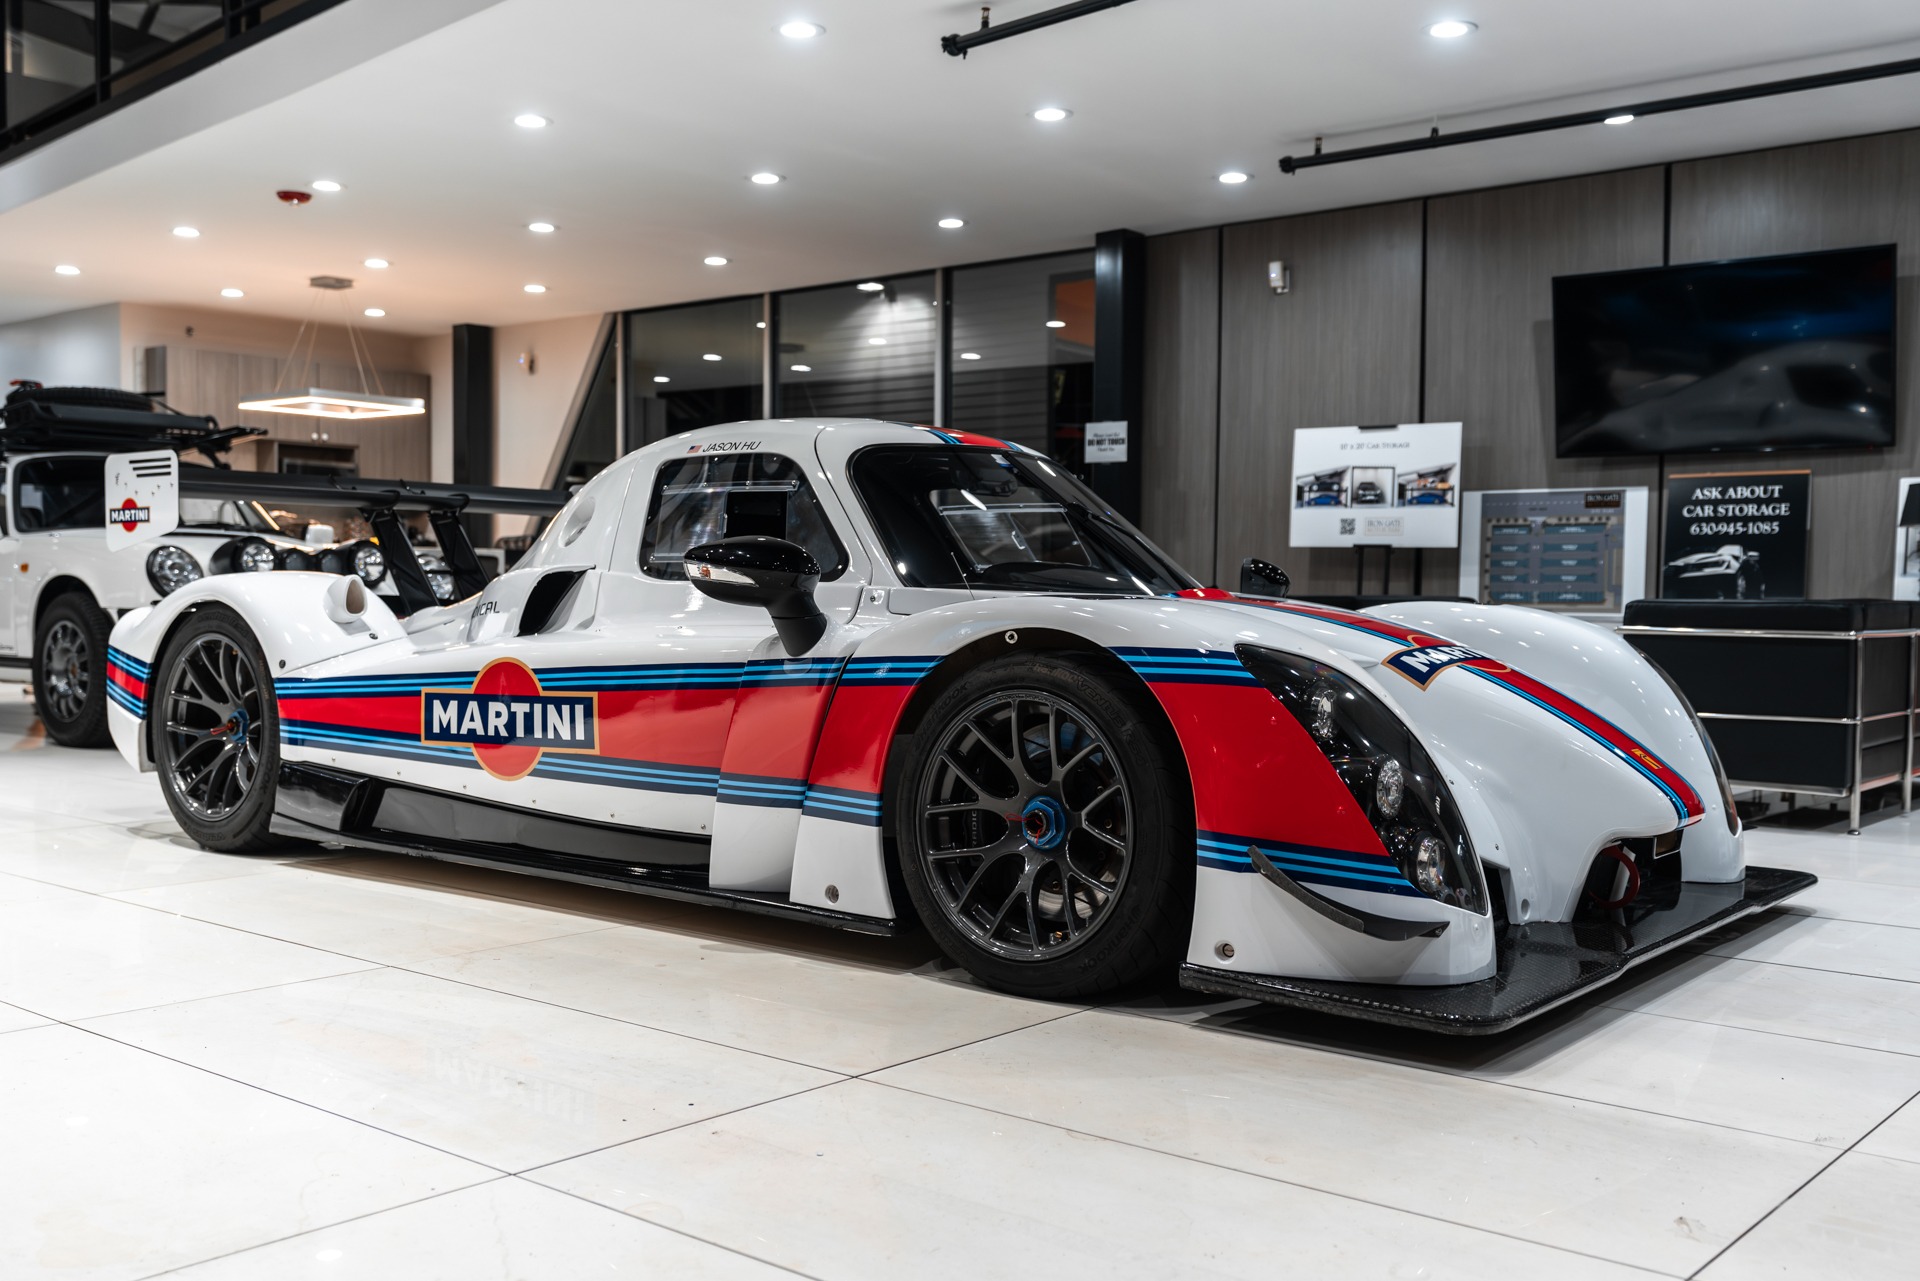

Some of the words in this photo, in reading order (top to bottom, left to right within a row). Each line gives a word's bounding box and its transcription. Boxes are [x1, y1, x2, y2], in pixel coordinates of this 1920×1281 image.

[702, 441, 742, 453] JASON
[741, 441, 762, 451] HU
[1692, 487, 1722, 500] ASK
[1725, 485, 1783, 499] ABOUT
[111, 508, 149, 522] MARTINI
[1682, 504, 1715, 518] CAR
[1717, 503, 1791, 517] STORAGE
[1689, 521, 1780, 536] 630-945-1085
[471, 600, 500, 619] DICAL
[432, 699, 585, 741] MARTINI
